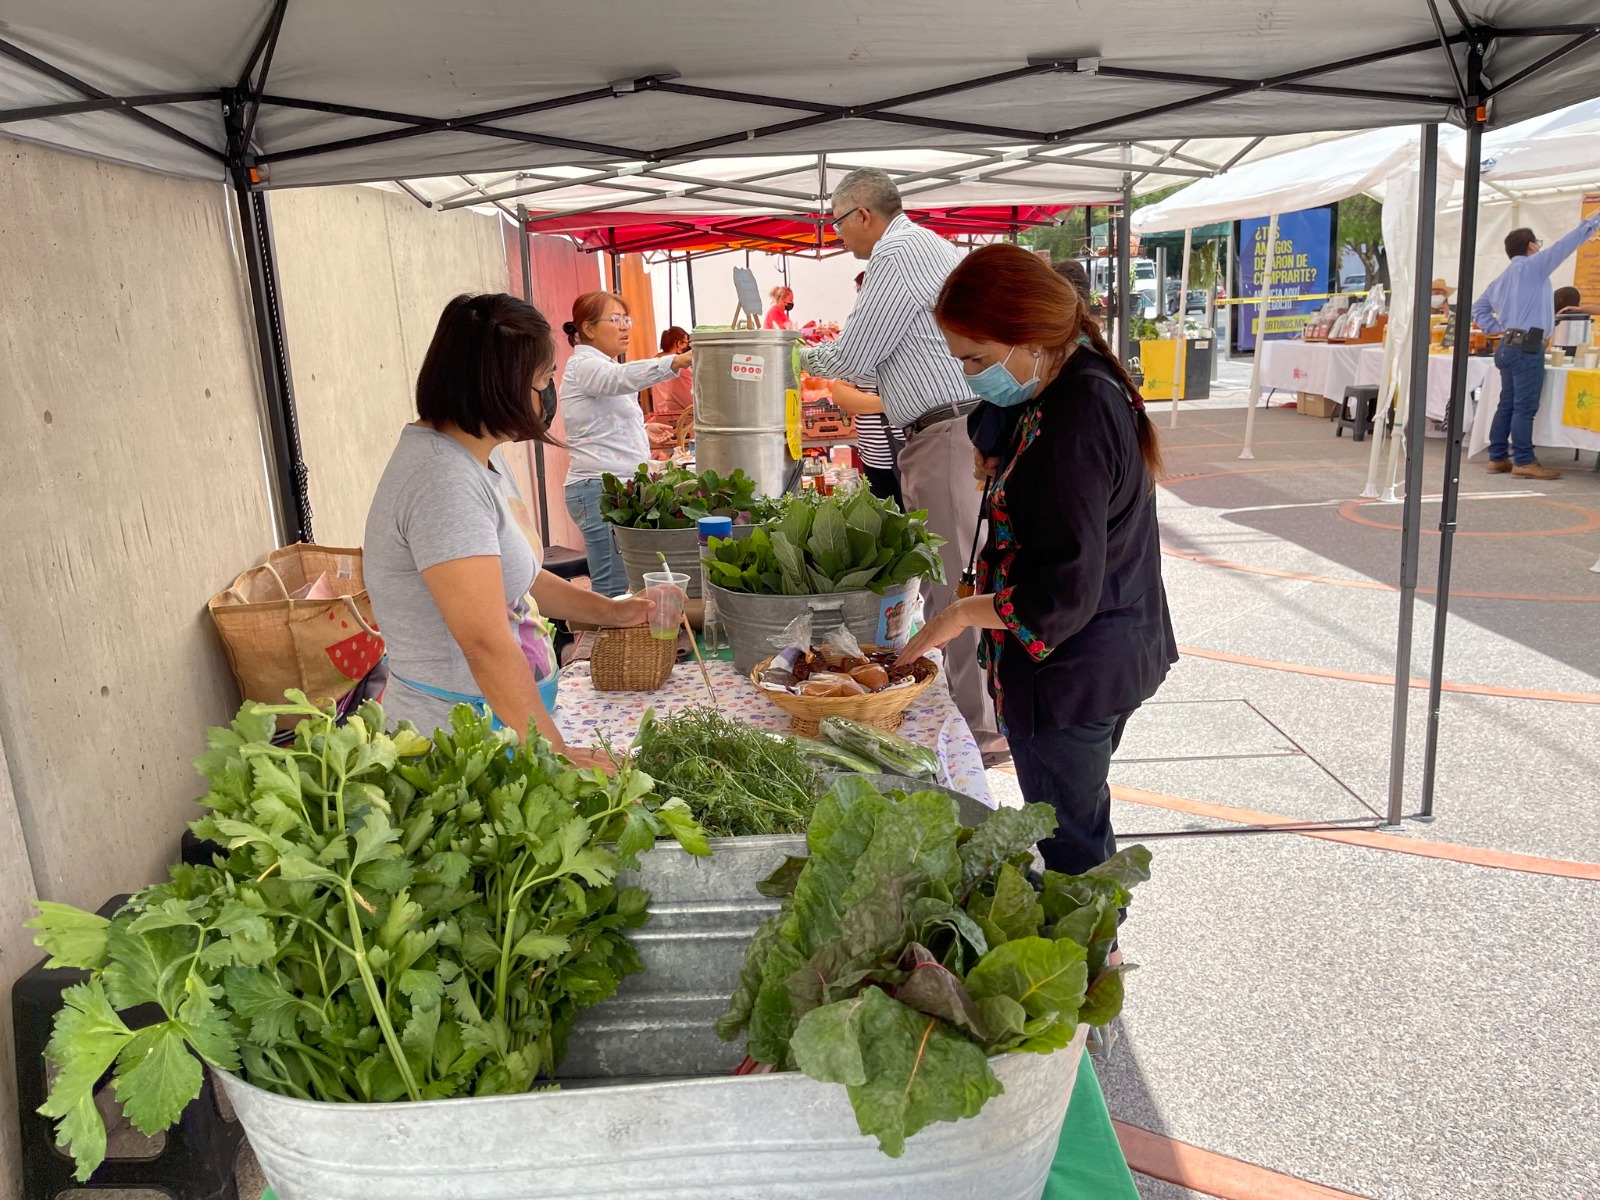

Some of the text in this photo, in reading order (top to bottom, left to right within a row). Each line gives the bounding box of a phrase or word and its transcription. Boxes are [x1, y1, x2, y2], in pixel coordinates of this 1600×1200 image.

[1254, 239, 1293, 256] AMGOS
[1254, 253, 1308, 271] DEARON DE
[1264, 299, 1292, 311] EGOCIO
[1256, 318, 1305, 331] ORTUNOS.MX
